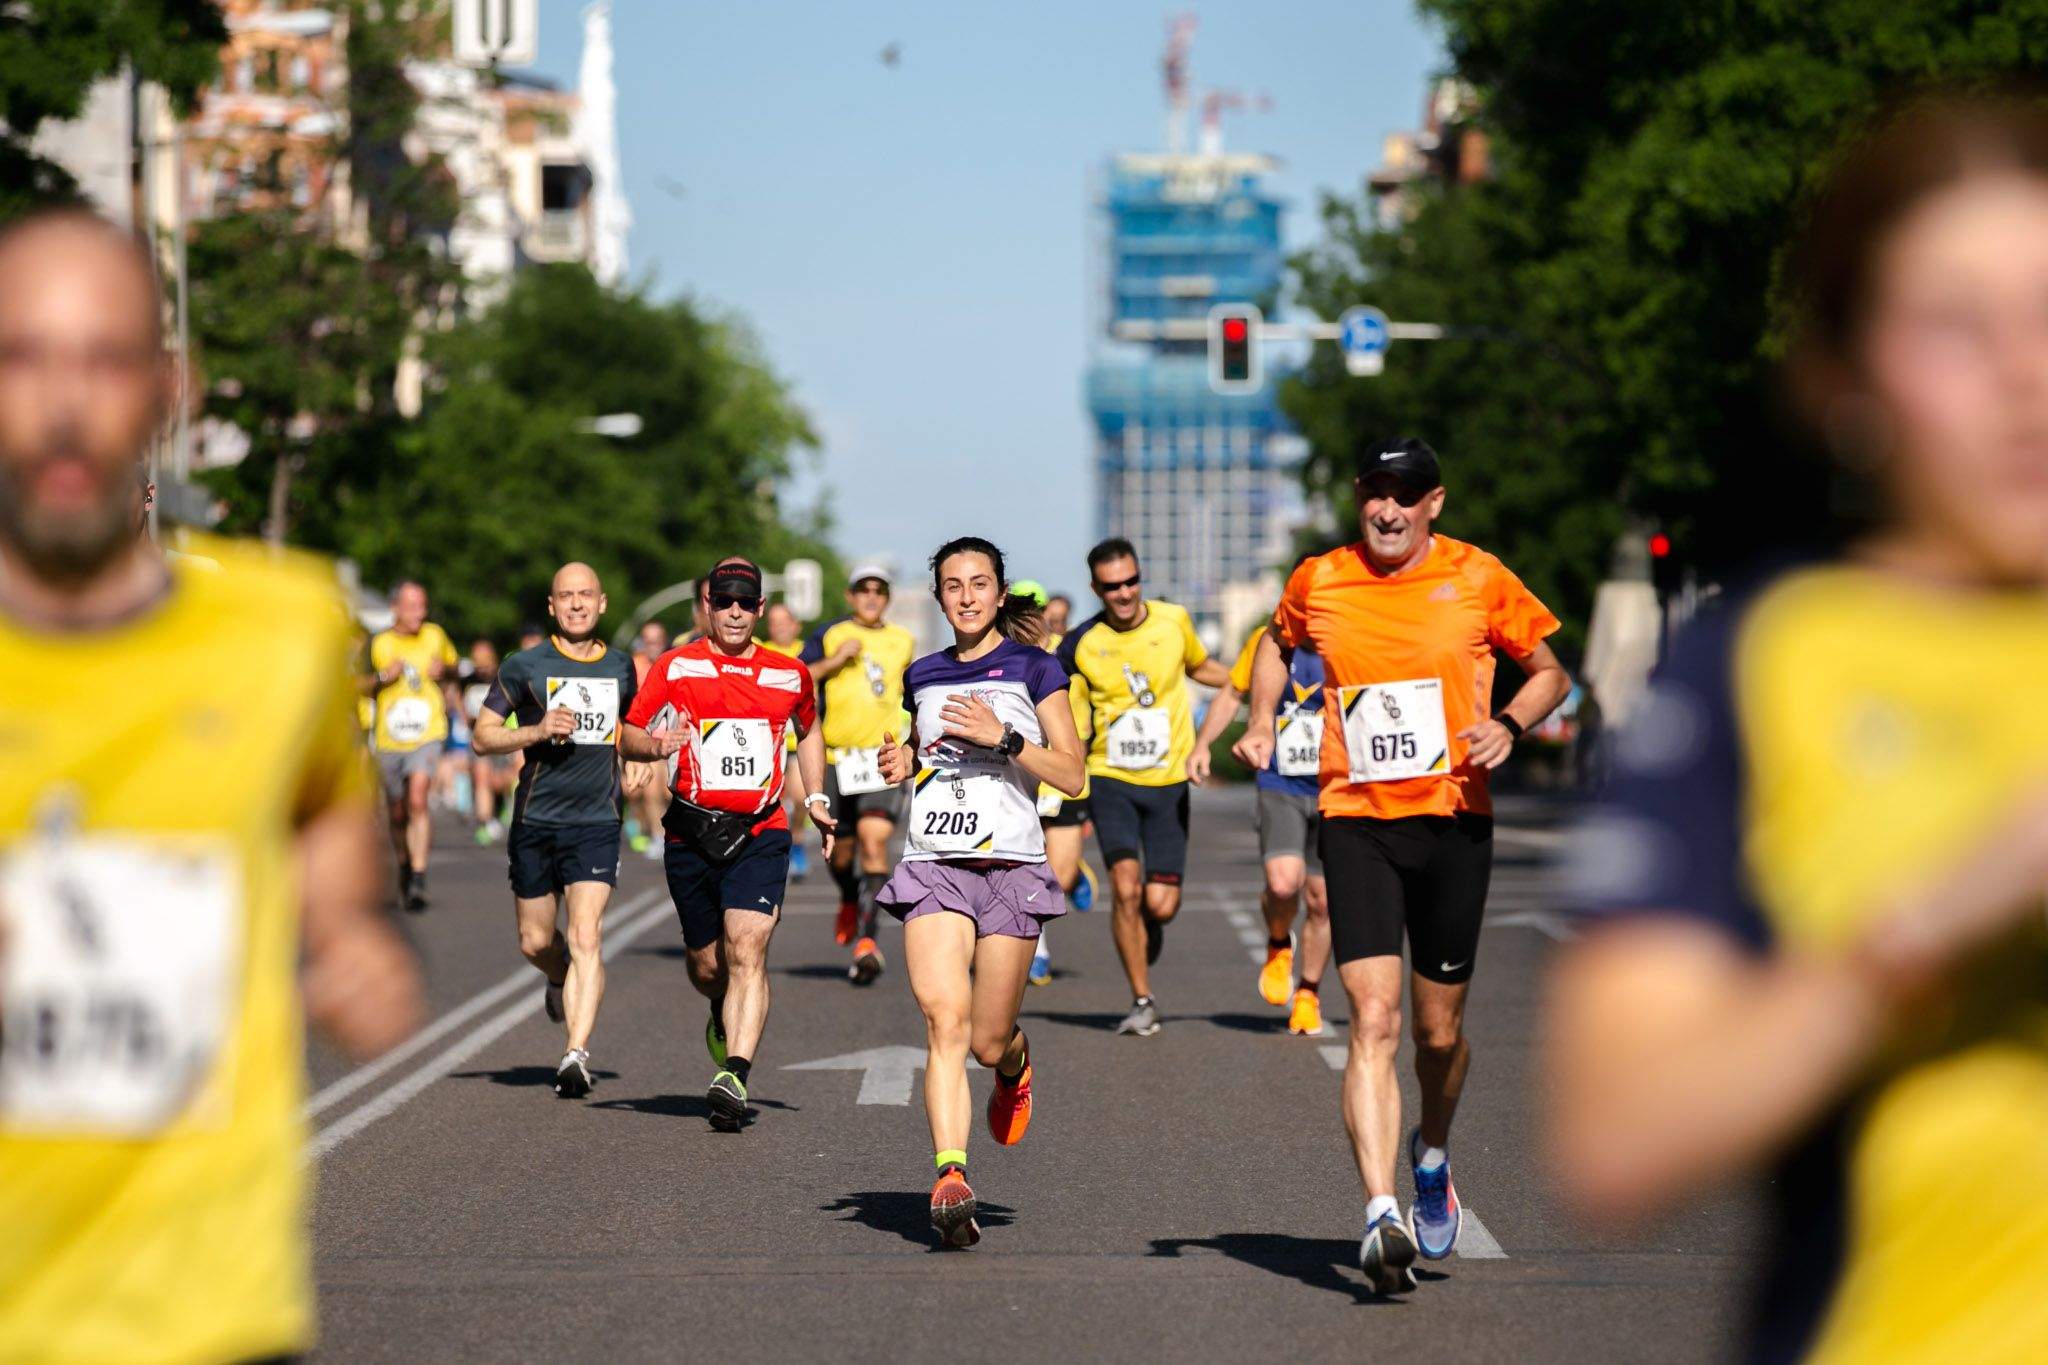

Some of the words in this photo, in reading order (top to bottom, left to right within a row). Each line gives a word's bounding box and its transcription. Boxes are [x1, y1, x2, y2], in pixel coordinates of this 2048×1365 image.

[1372, 733, 1417, 762] 675
[722, 757, 754, 776] 851
[923, 811, 978, 836] 2203
